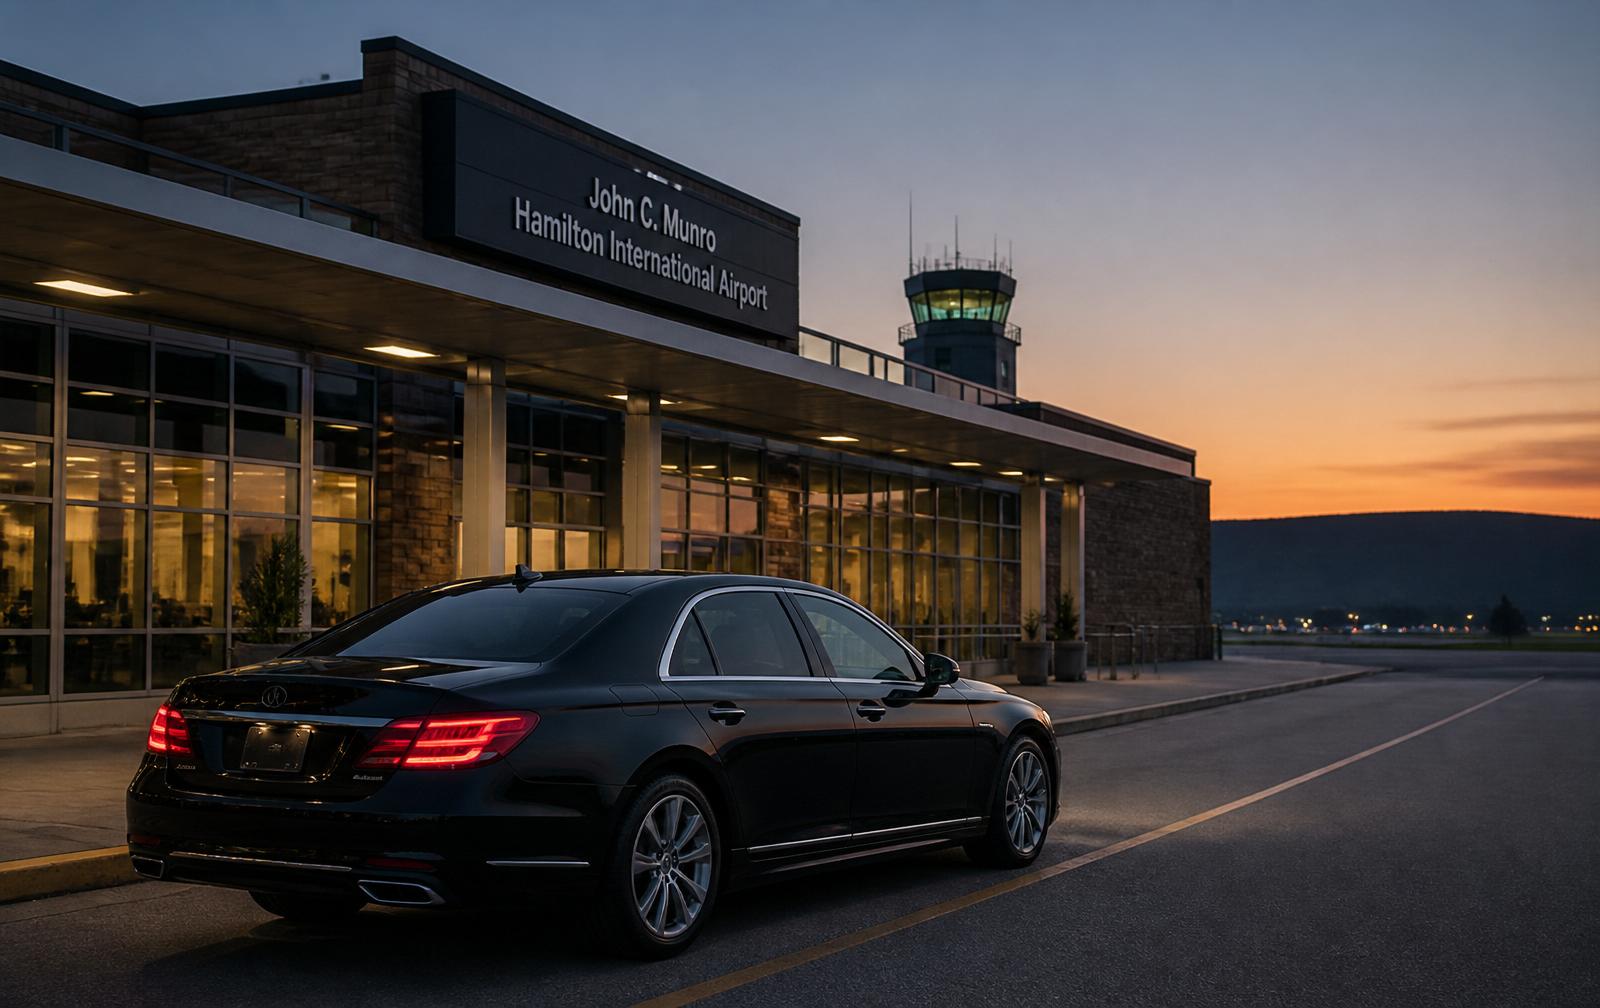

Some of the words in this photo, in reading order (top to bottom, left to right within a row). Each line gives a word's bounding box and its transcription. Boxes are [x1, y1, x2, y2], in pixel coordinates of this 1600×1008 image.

[514, 196, 604, 257] Hamilton
[610, 229, 715, 293] International
[718, 269, 769, 311] Airport
[589, 177, 635, 222] John
[640, 196, 659, 232] C.
[663, 203, 717, 253] Munro
